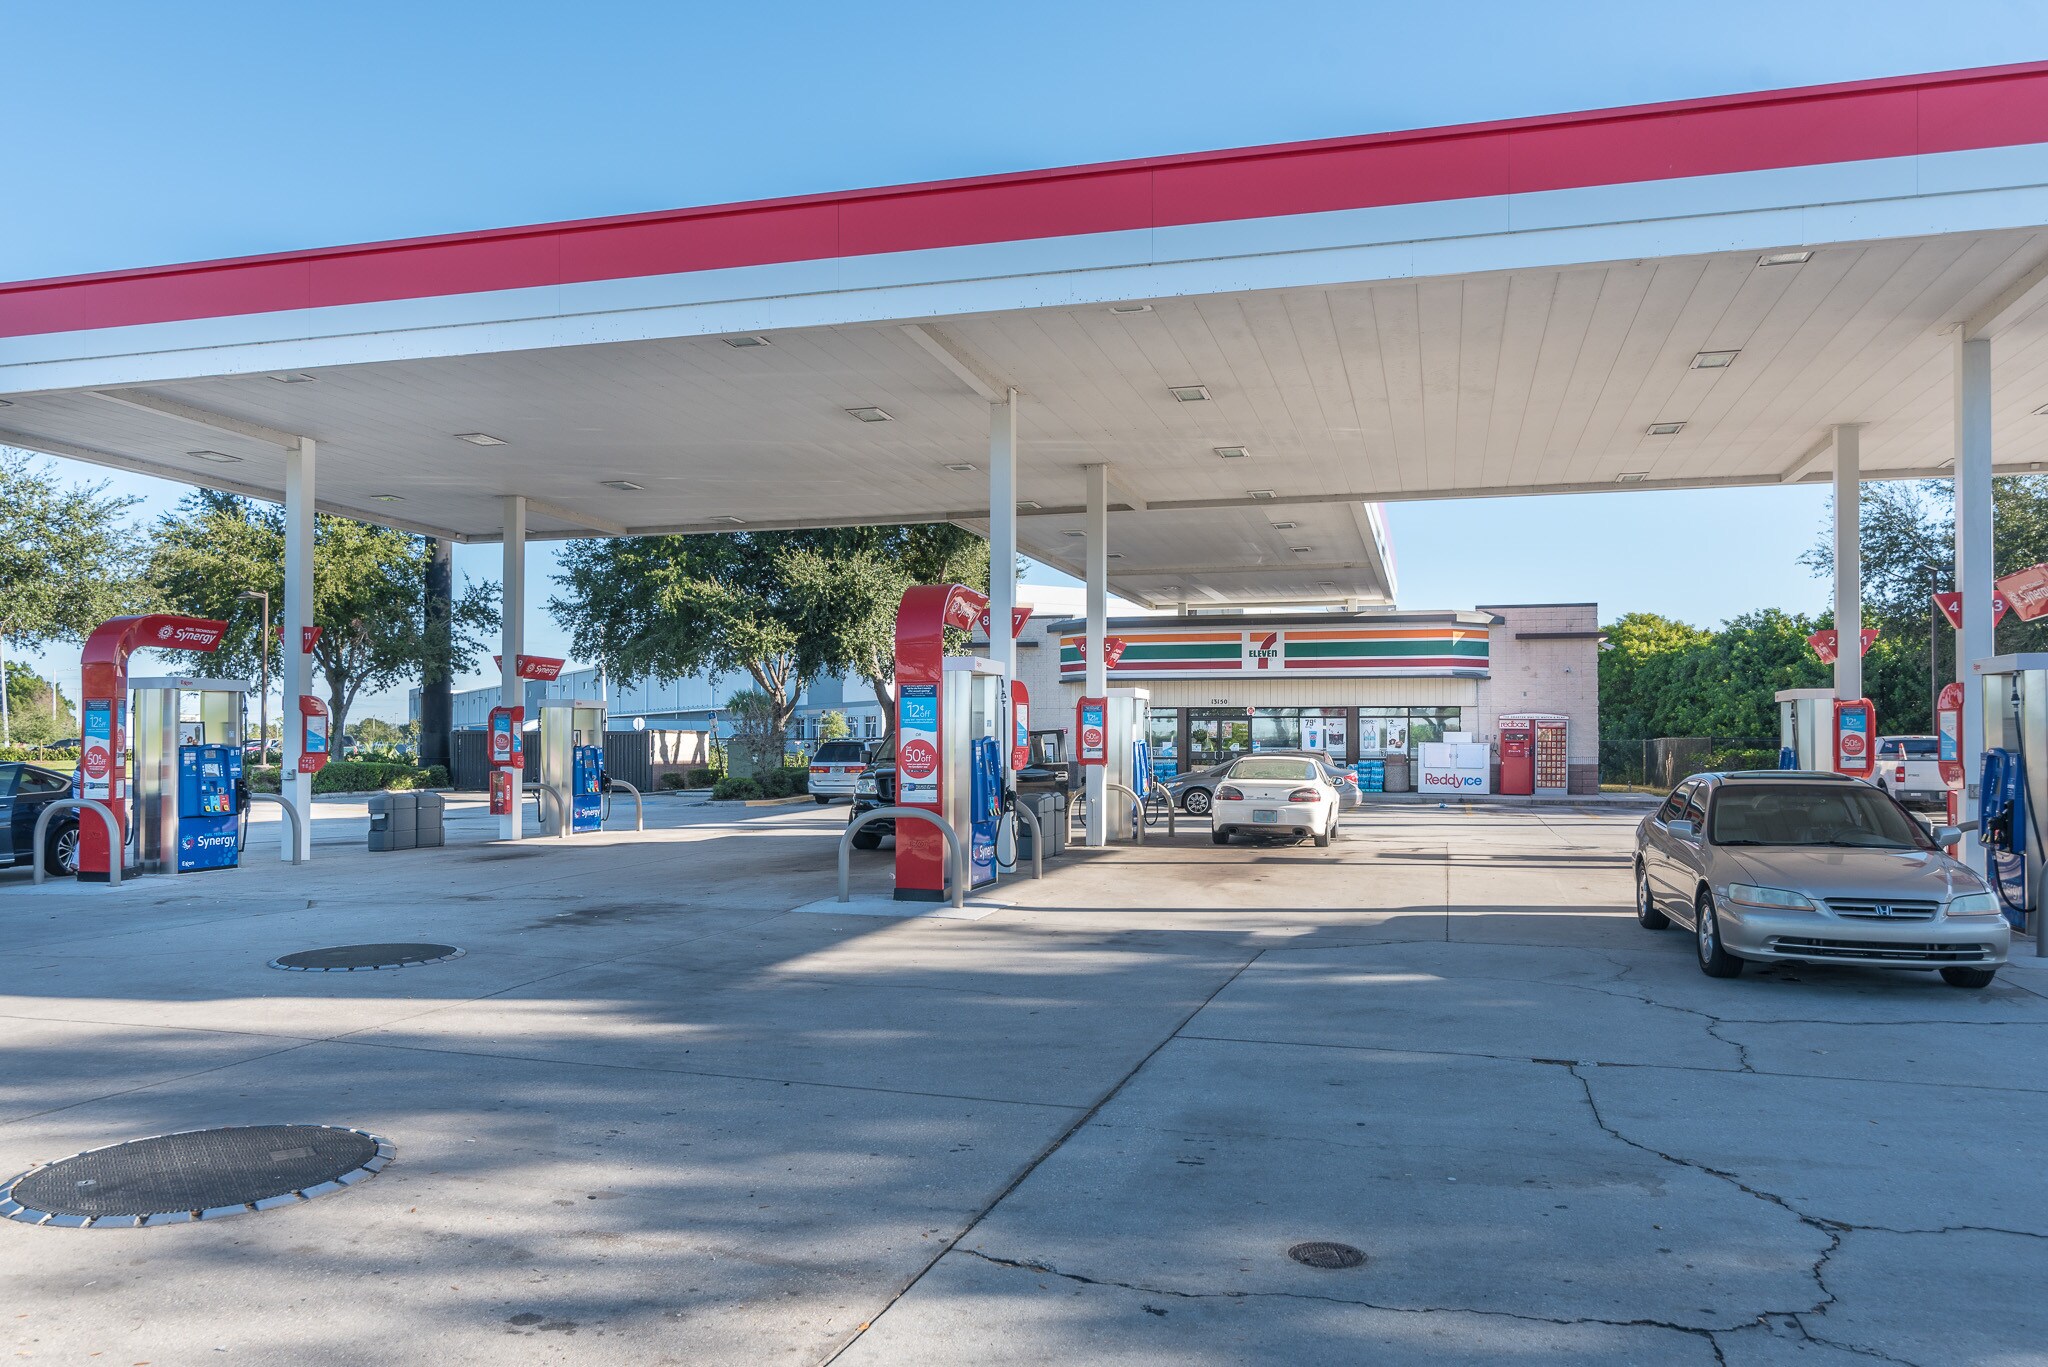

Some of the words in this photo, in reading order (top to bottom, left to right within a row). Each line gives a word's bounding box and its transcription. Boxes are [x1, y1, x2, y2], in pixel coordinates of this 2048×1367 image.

[1948, 601, 1959, 613] 4
[1993, 600, 2003, 612] 3
[982, 615, 990, 626] 8
[1014, 615, 1022, 625] 7
[174, 628, 217, 645] Synergy
[304, 632, 312, 640] 11
[1828, 636, 1836, 646] 2
[1861, 636, 1867, 646] 1
[1080, 644, 1086, 652] 6
[1105, 643, 1111, 652] 5
[1258, 632, 1277, 669] 7
[517, 659, 523, 667] 9
[535, 665, 559, 676] Synergy
[920, 710, 931, 718] off
[905, 749, 926, 763] 50¢
[921, 754, 932, 762] off
[581, 808, 601, 818] Synergy
[197, 835, 236, 850] Synergy
